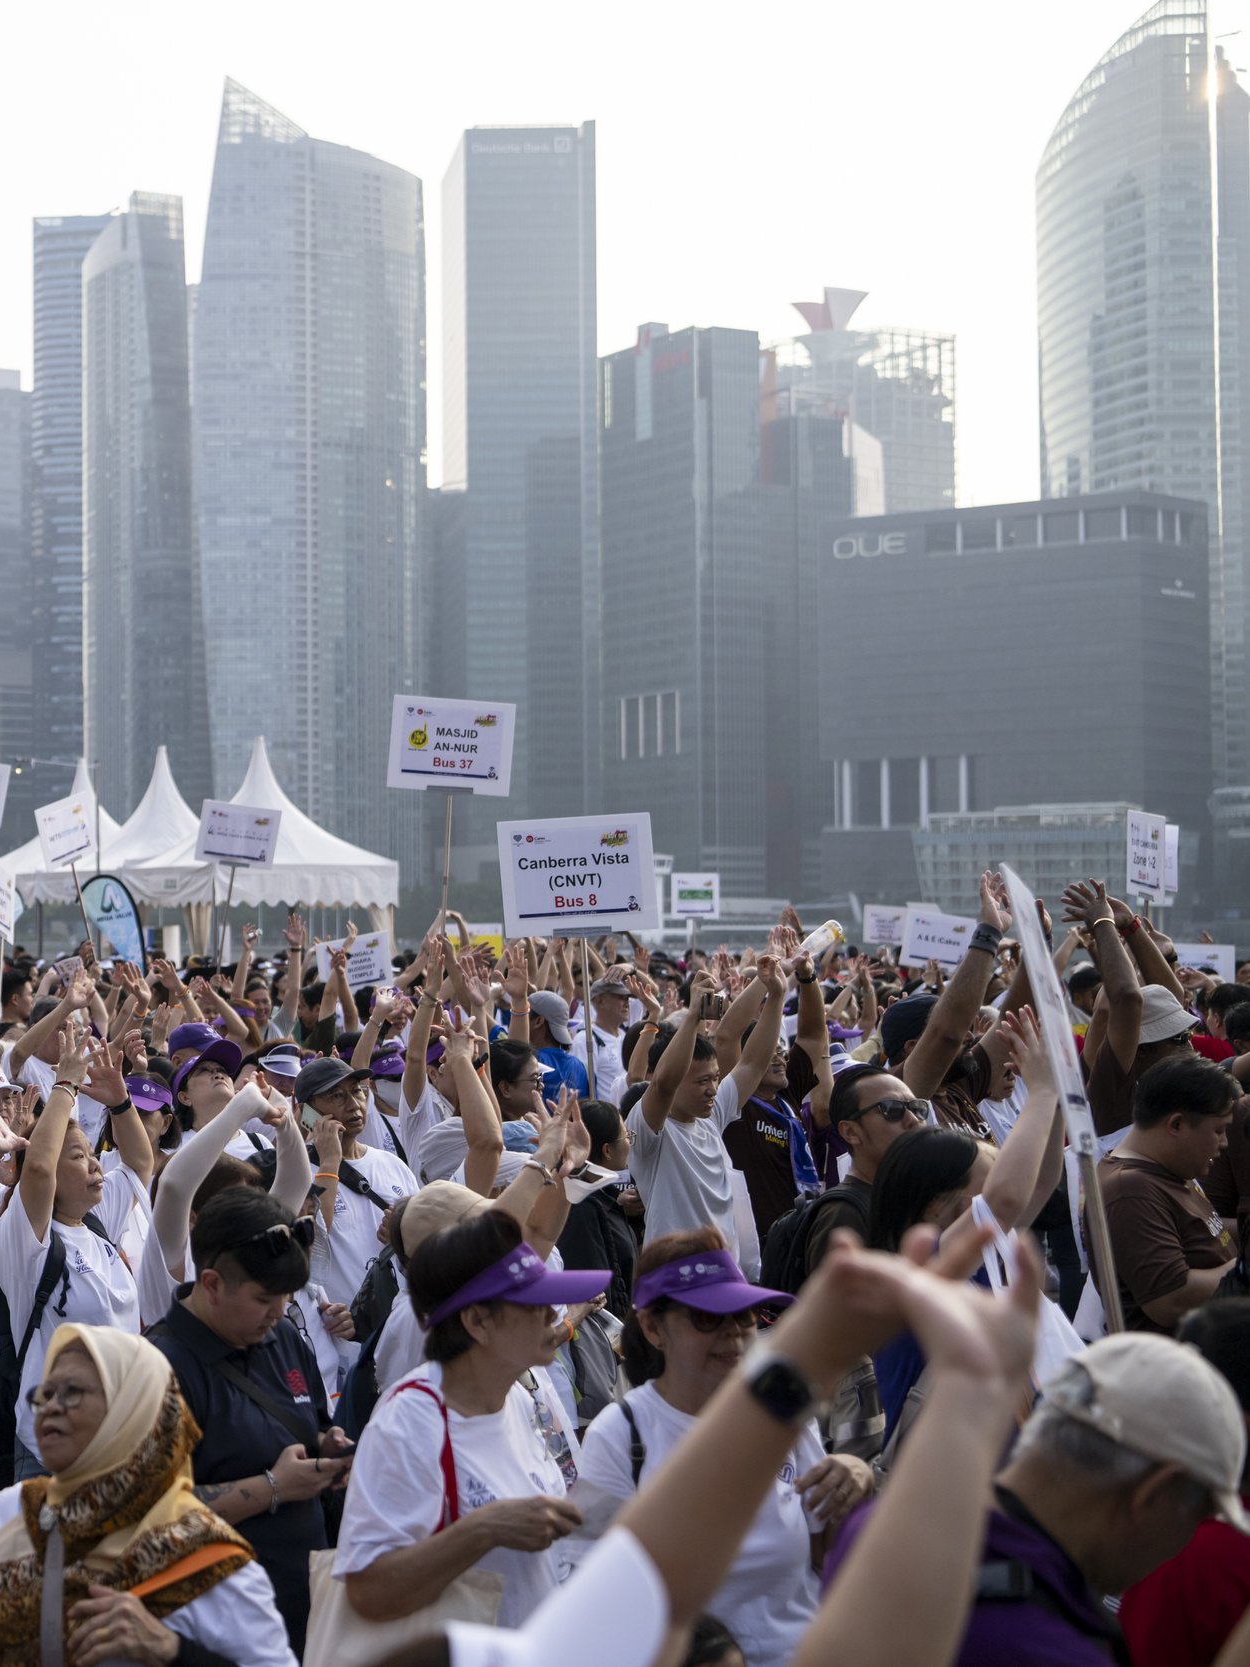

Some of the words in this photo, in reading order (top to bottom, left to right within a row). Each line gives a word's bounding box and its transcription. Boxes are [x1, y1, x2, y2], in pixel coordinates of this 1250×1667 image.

[832, 532, 907, 559] OUE
[436, 727, 478, 739] MASJID
[433, 742, 478, 754] AN-NUR
[433, 757, 456, 768] Bus
[459, 759, 473, 769] 37
[518, 857, 587, 870] Canberra
[591, 853, 630, 866] Vista
[548, 872, 602, 891] (CNVT)
[554, 896, 584, 908] Bus
[588, 894, 598, 906] 8
[917, 933, 923, 941] A
[924, 934, 930, 942] &
[931, 935, 936, 943] E
[350, 950, 374, 958] ANGALA
